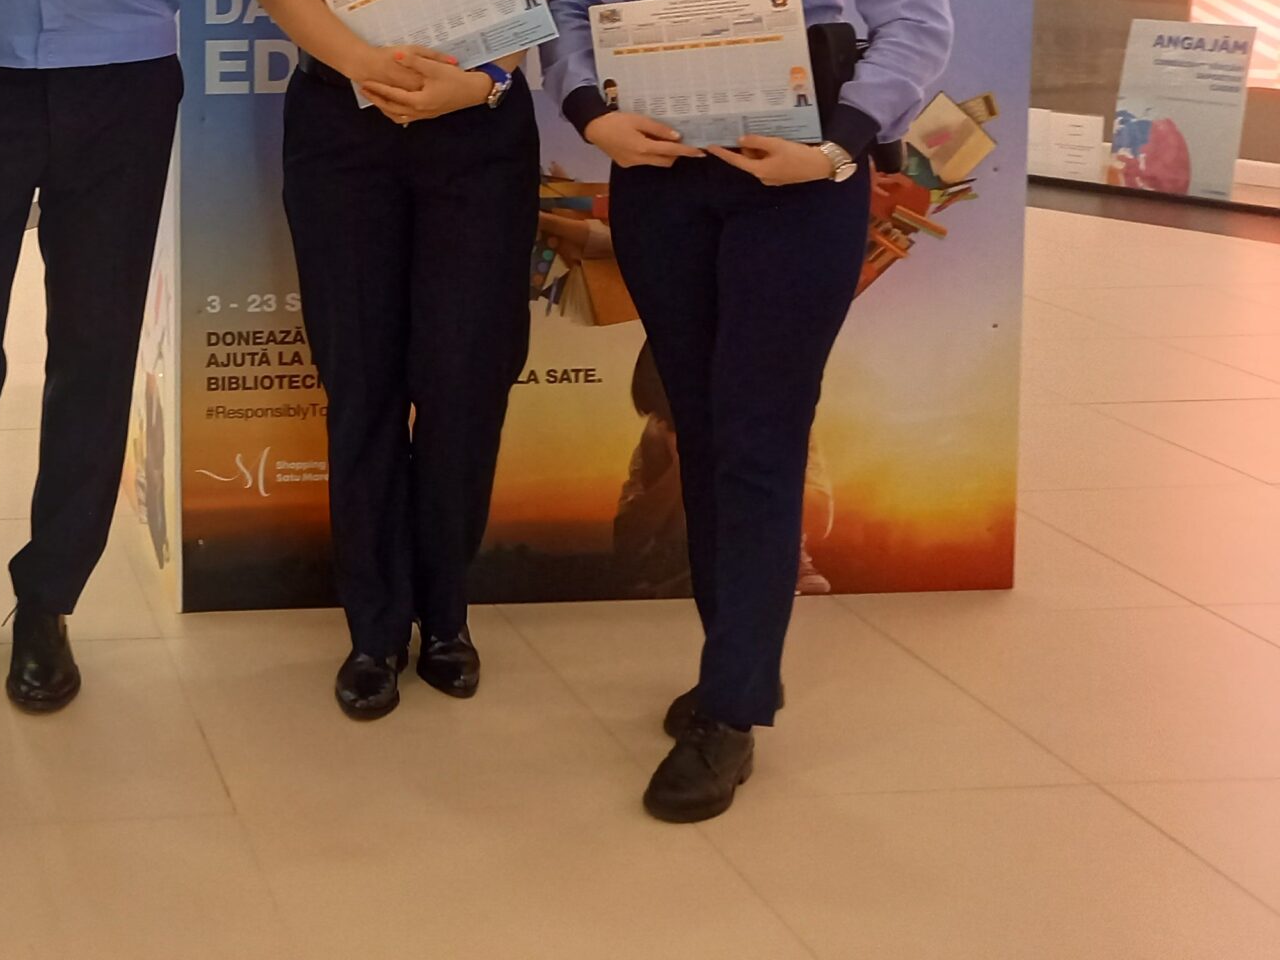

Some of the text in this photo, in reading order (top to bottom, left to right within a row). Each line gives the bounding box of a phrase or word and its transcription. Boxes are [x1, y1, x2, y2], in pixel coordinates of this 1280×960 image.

[1153, 34, 1248, 55] ANGAJĂM
[205, 295, 221, 313] 3
[246, 294, 277, 313] 23
[205, 326, 306, 347] DONEAZĂ
[205, 348, 304, 368] AJUTĂ LA
[545, 367, 603, 385] SATE.
